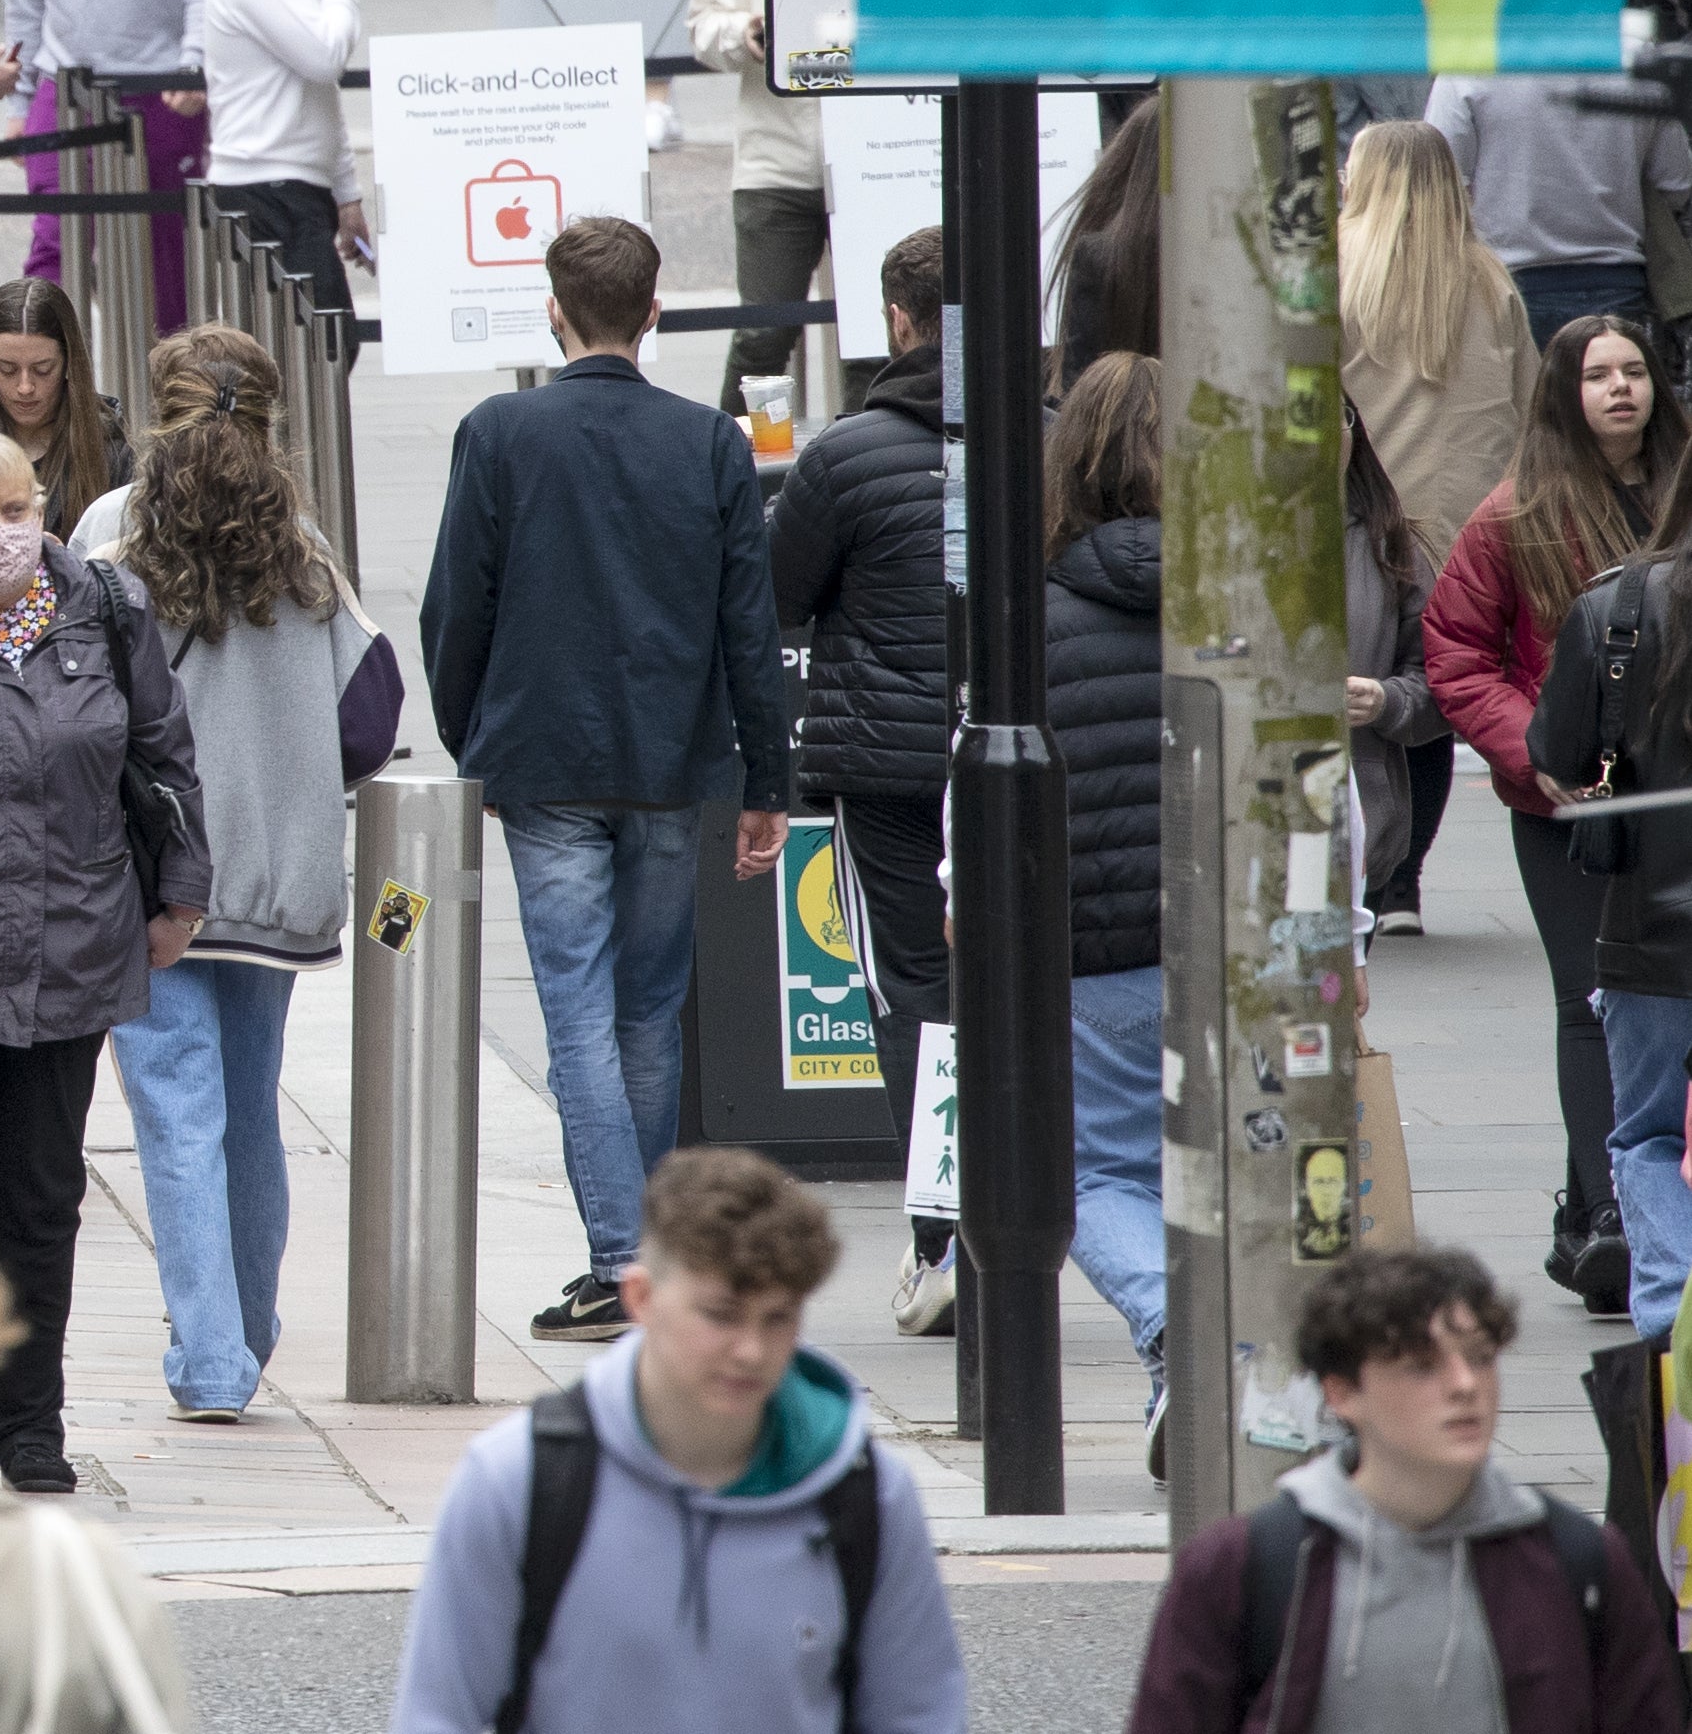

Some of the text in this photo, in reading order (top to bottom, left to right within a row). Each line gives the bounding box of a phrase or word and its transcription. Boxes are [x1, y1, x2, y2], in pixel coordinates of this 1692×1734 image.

[397, 66, 618, 96] Click-and-Collect
[406, 109, 438, 119] Please
[440, 108, 460, 117] wait
[463, 107, 475, 116] for
[478, 106, 493, 116] the
[496, 105, 516, 115] next
[518, 102, 561, 114] available
[433, 119, 587, 136] Make sure to have your QR code
[464, 137, 483, 147] and
[484, 135, 513, 148] photo
[515, 134, 526, 145] ID
[866, 140, 881, 150] No
[861, 171, 893, 182] Please
[896, 170, 916, 179] wait
[918, 169, 931, 177] for
[799, 1060, 842, 1076] CITY
